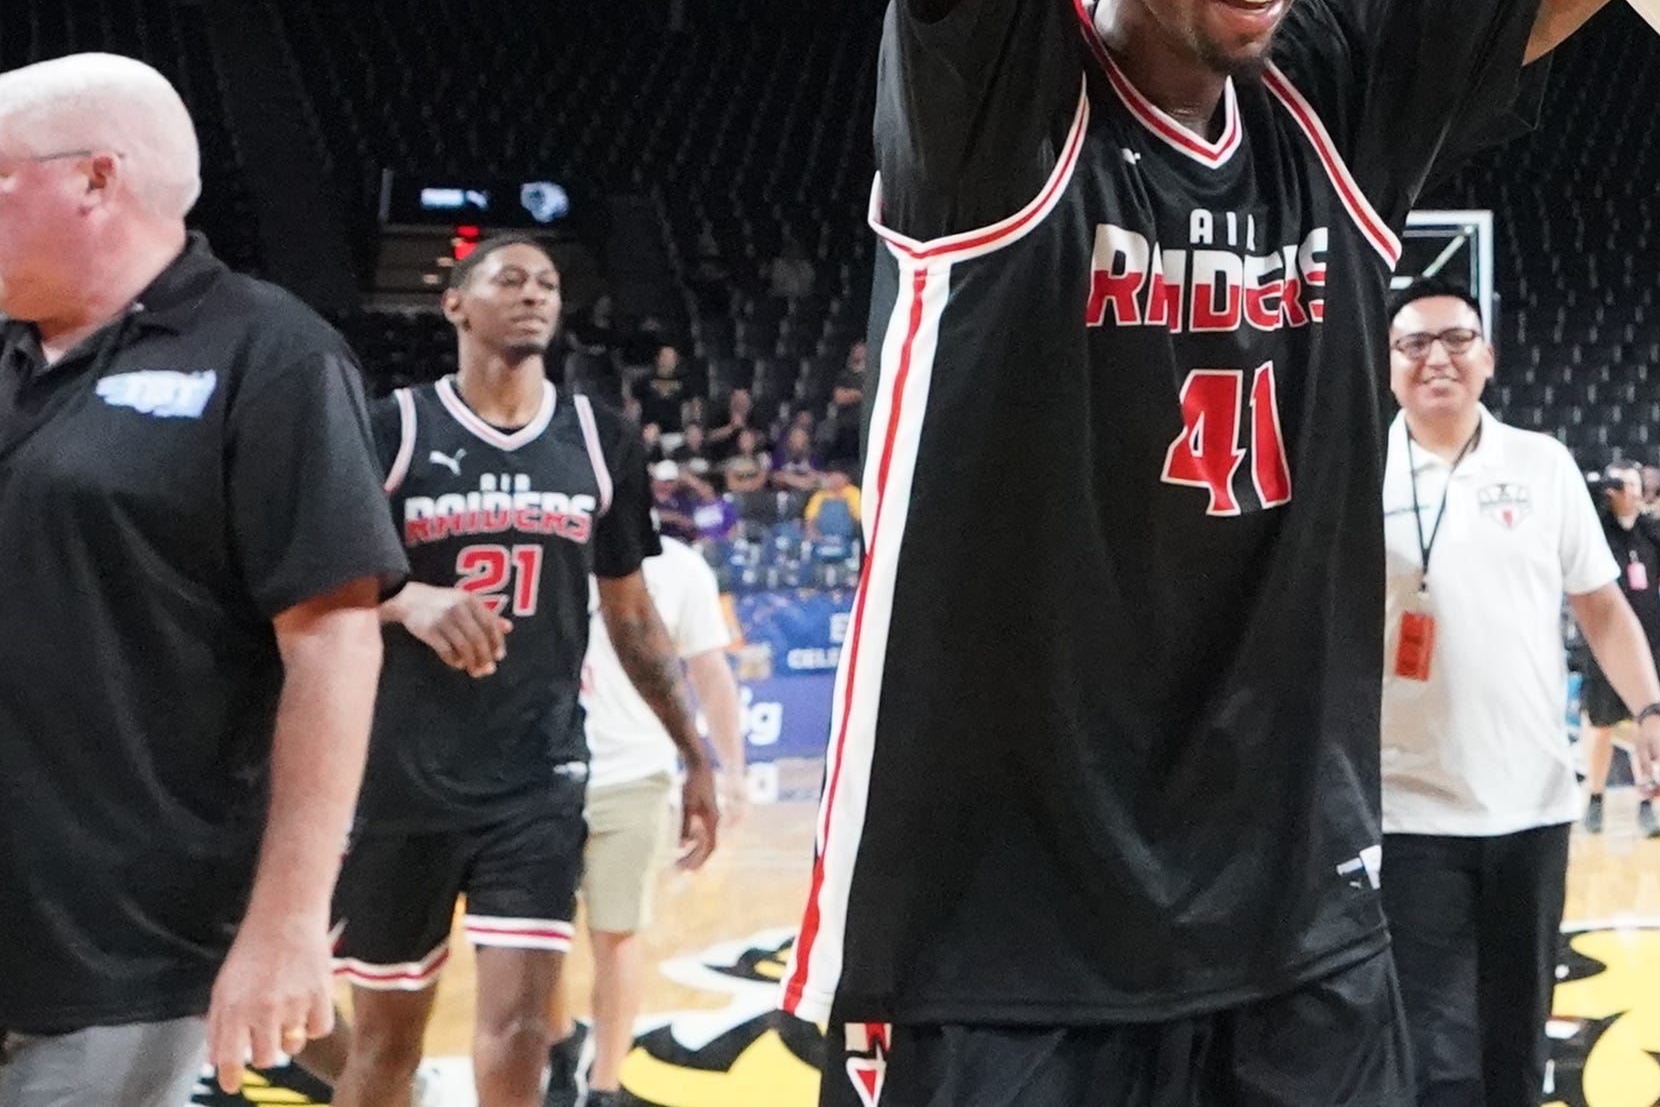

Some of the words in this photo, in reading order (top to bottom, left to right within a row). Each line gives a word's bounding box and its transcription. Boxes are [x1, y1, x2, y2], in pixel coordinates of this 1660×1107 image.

[1160, 360, 1292, 516] 41
[404, 492, 597, 545] RAIDERS
[455, 544, 543, 617] 21
